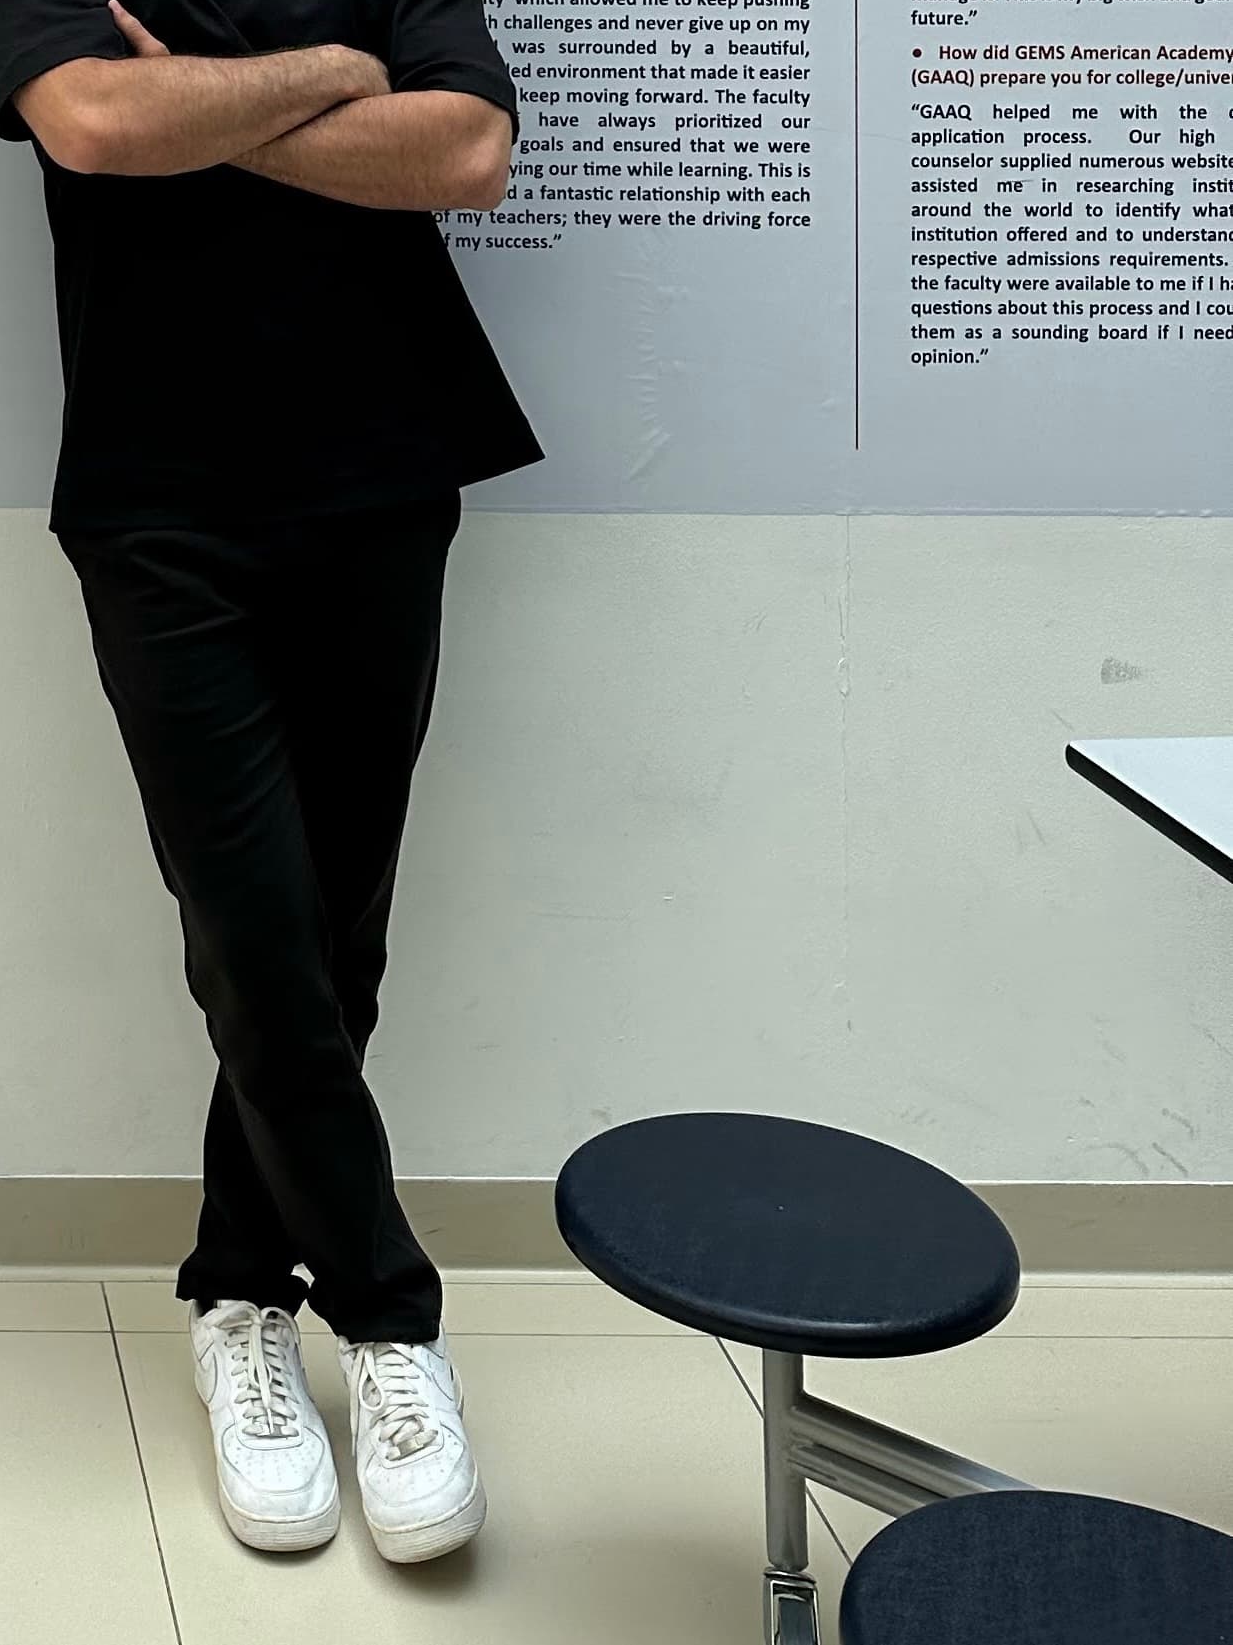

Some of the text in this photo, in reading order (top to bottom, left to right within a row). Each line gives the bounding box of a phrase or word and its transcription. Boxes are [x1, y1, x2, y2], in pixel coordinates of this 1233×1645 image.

[539, 112, 811, 131] have always prioritized our
[912, 251, 1228, 269] respective admissions requirements.
